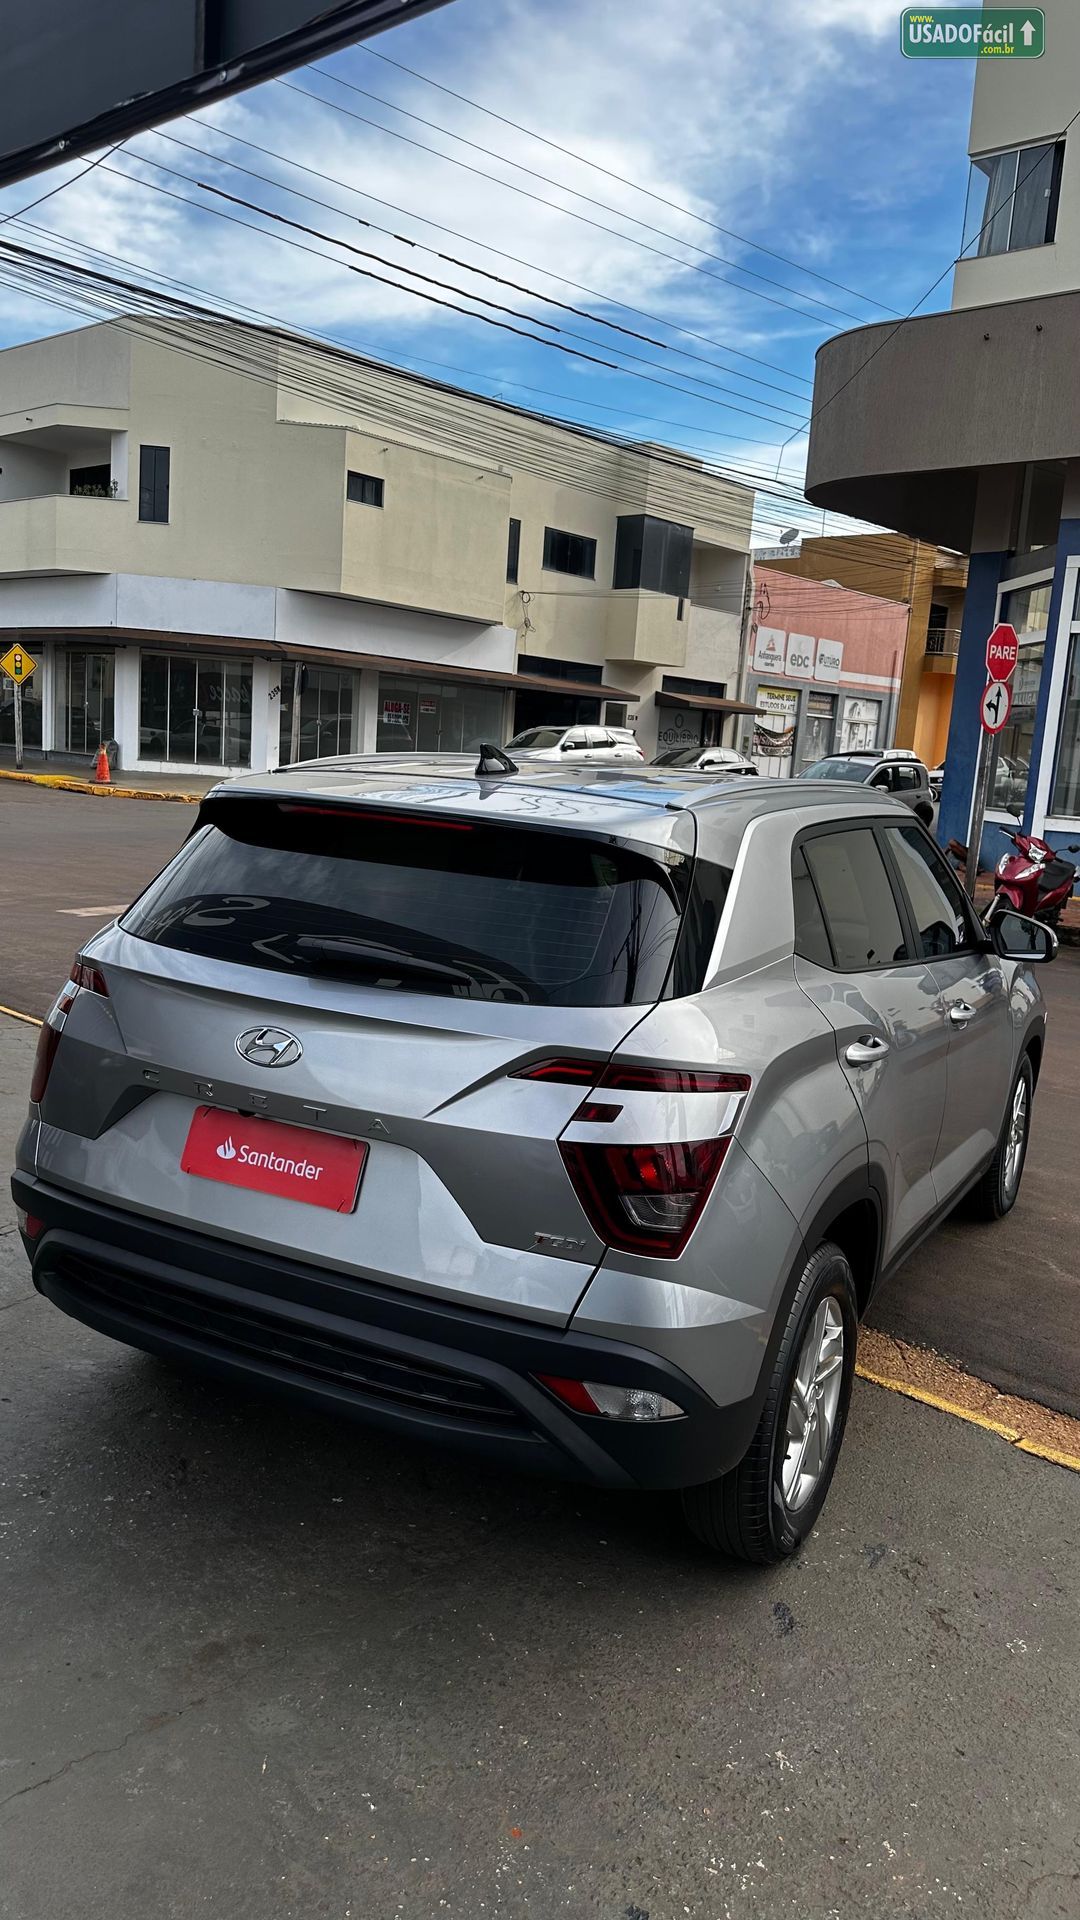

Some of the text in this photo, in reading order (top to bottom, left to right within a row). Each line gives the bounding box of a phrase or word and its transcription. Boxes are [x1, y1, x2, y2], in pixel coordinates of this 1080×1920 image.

[989, 644, 1017, 660] PARE
[767, 692, 796, 702] TERMINE SEUS
[384, 701, 410, 714] ALUGA-SE
[760, 701, 779, 709] ESTUDOS
[142, 1069, 391, 1135] CRETA
[238, 1145, 324, 1181] Santander
